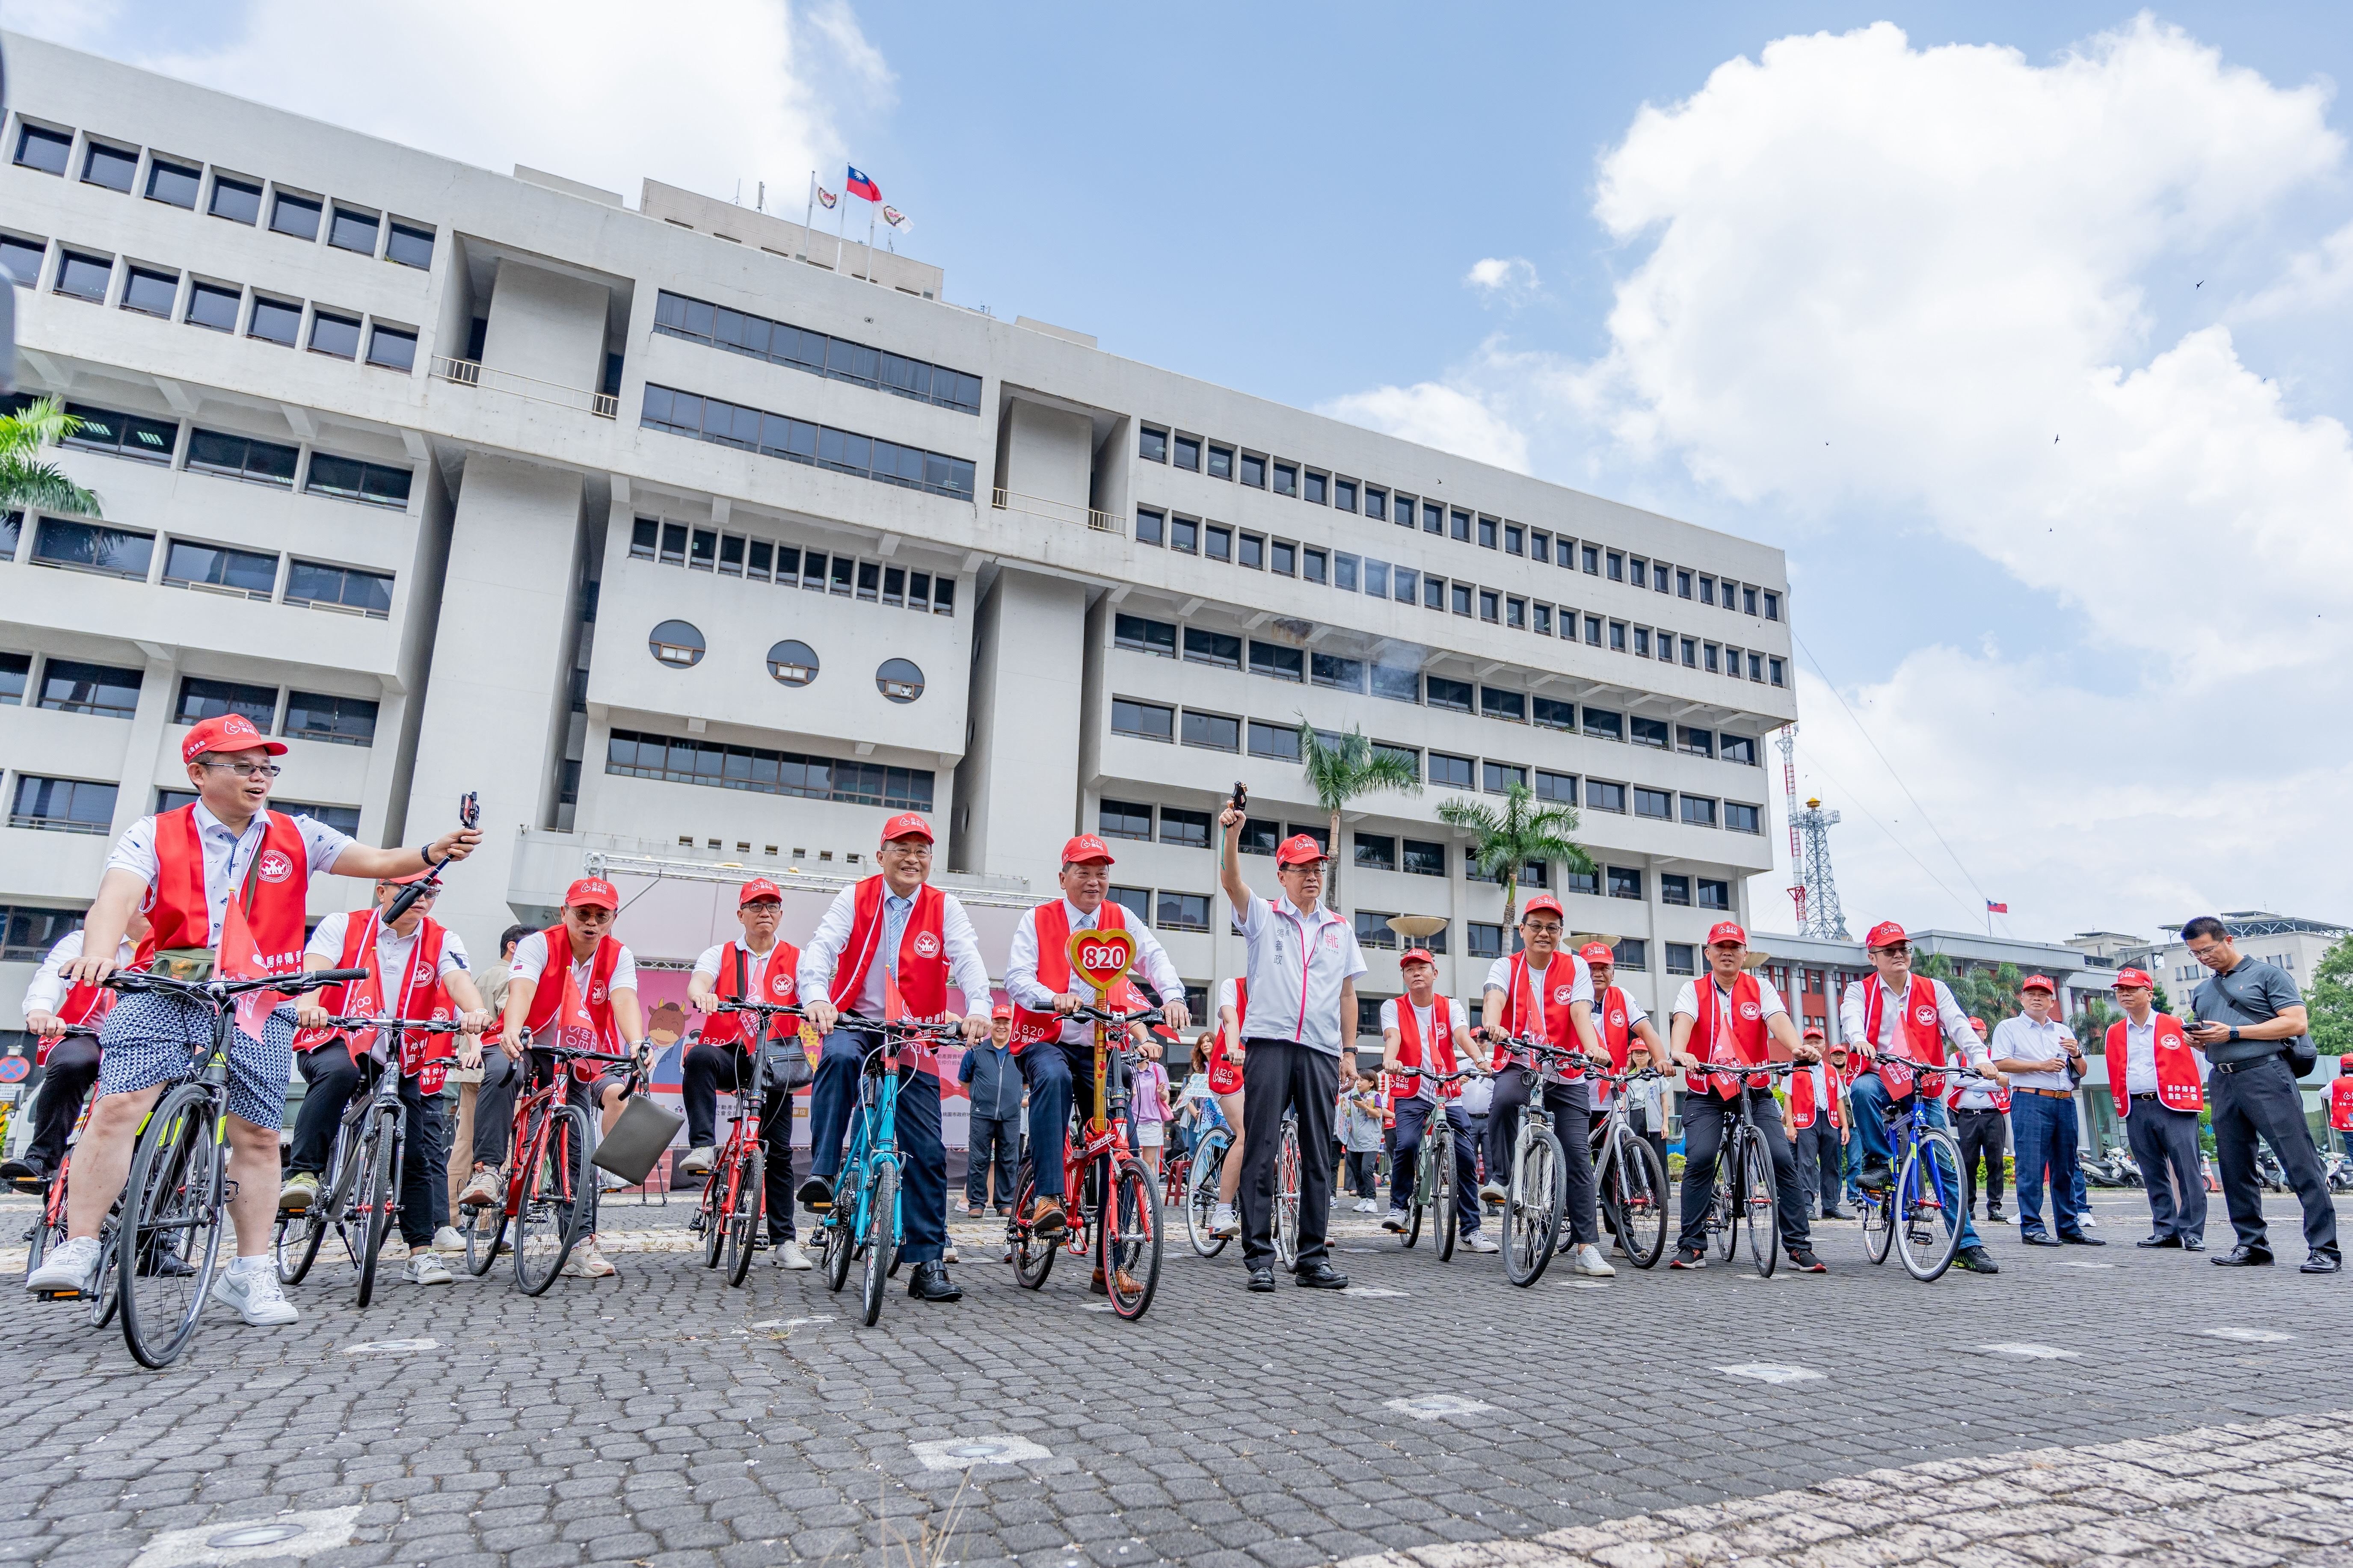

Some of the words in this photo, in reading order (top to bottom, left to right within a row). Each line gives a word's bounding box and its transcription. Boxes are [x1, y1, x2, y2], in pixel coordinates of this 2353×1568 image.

[237, 721, 254, 731] 820
[241, 727, 258, 737] 房仲
[187, 740, 206, 756] 公益捐血
[911, 821, 925, 829] 房仲日
[1285, 923, 1290, 936] 市長
[1273, 928, 1284, 965] 張善政
[266, 950, 301, 968] 房仲傳愛
[1084, 947, 1125, 967] 820
[1022, 1024, 1044, 1037] 820
[703, 1037, 726, 1045] 820
[1219, 1068, 1233, 1078] 820
[1218, 1076, 1233, 1085] 房仲日
[2168, 1085, 2197, 1093] 房仲傳愛
